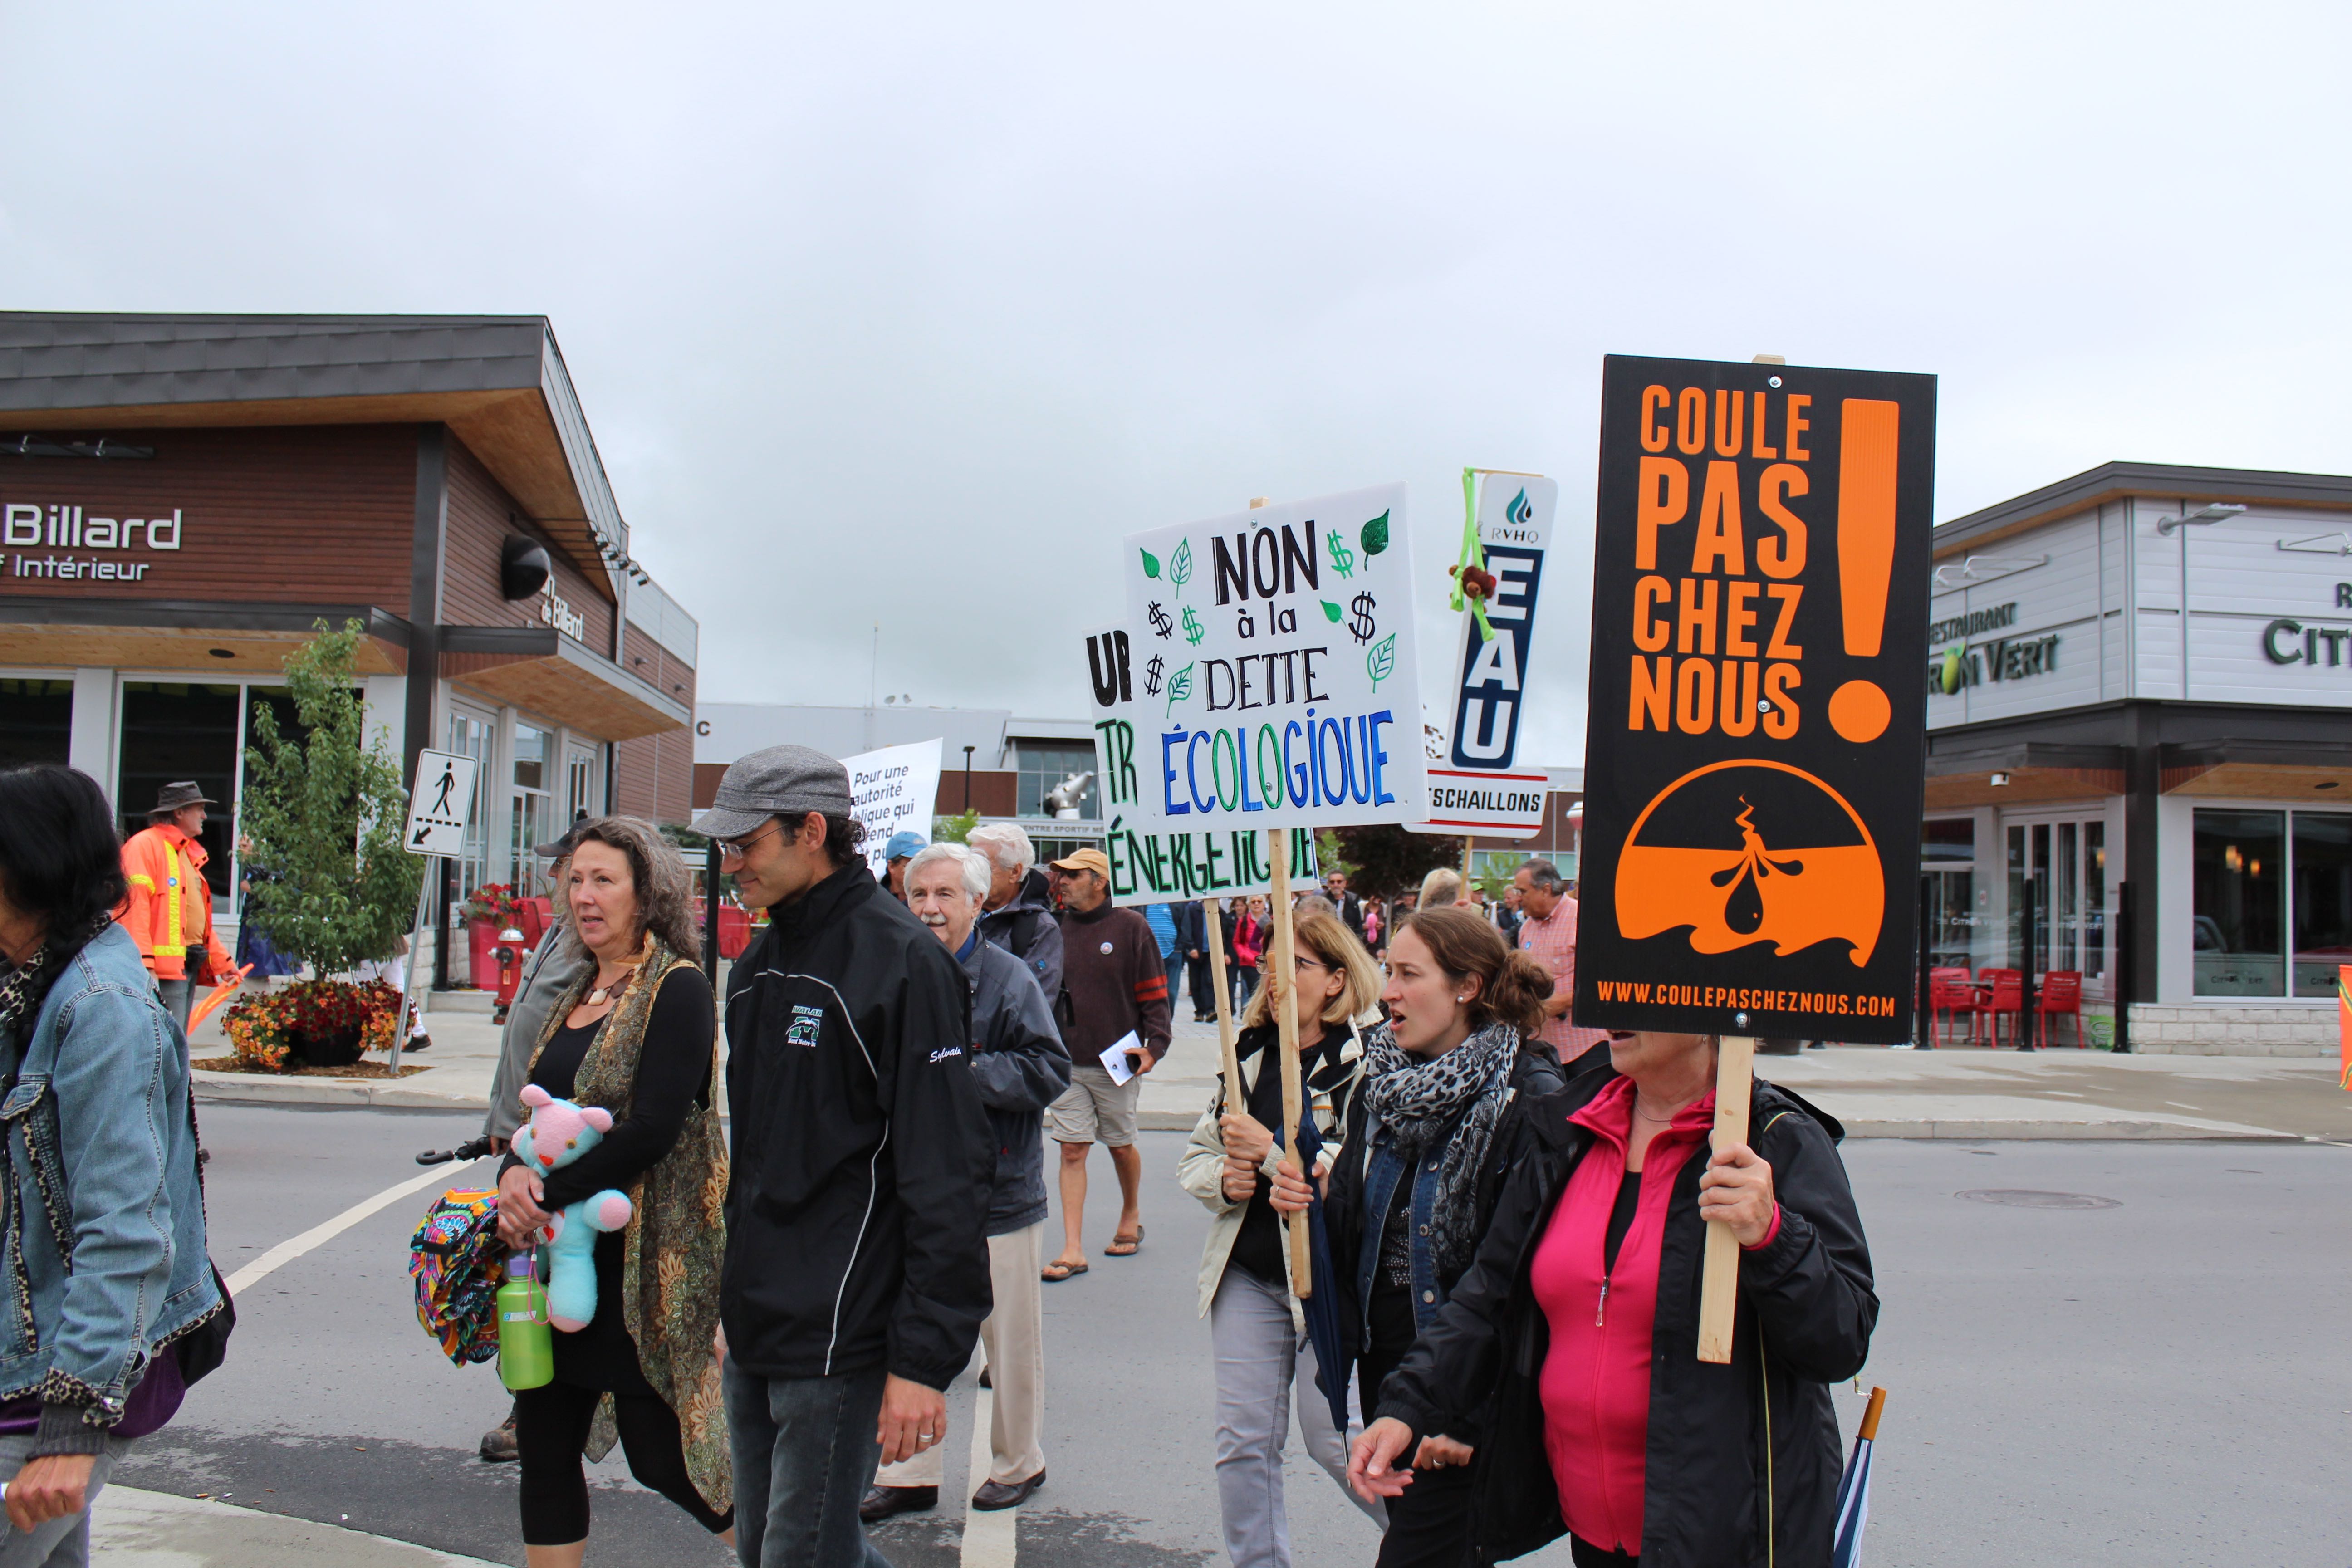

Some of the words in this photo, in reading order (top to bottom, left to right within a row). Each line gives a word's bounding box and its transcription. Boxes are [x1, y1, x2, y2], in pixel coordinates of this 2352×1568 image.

[1641, 385, 1812, 461] COULE
[4, 504, 181, 549] Billard
[1635, 456, 1809, 580] PAS
[15, 554, 149, 580] Intérieur
[1211, 520, 1319, 606] NON
[553, 595, 584, 642] Billard
[1238, 608, 1255, 638] à
[1269, 601, 1297, 636] la
[1632, 575, 1804, 660] CHEZ
[1983, 634, 2057, 682] VERT
[2263, 619, 2352, 667] CIT
[1201, 647, 1330, 711] DETTE
[1628, 654, 1802, 740] NOUS
[853, 769, 882, 788] Pour
[884, 765, 909, 779] une
[1095, 717, 1138, 807] TR
[853, 780, 902, 807] autorité
[893, 798, 915, 821] qui
[1429, 788, 1541, 812] SCHAILLONS
[1597, 980, 1895, 1017] WWW.COULEPASCHEZNOUS.COM
